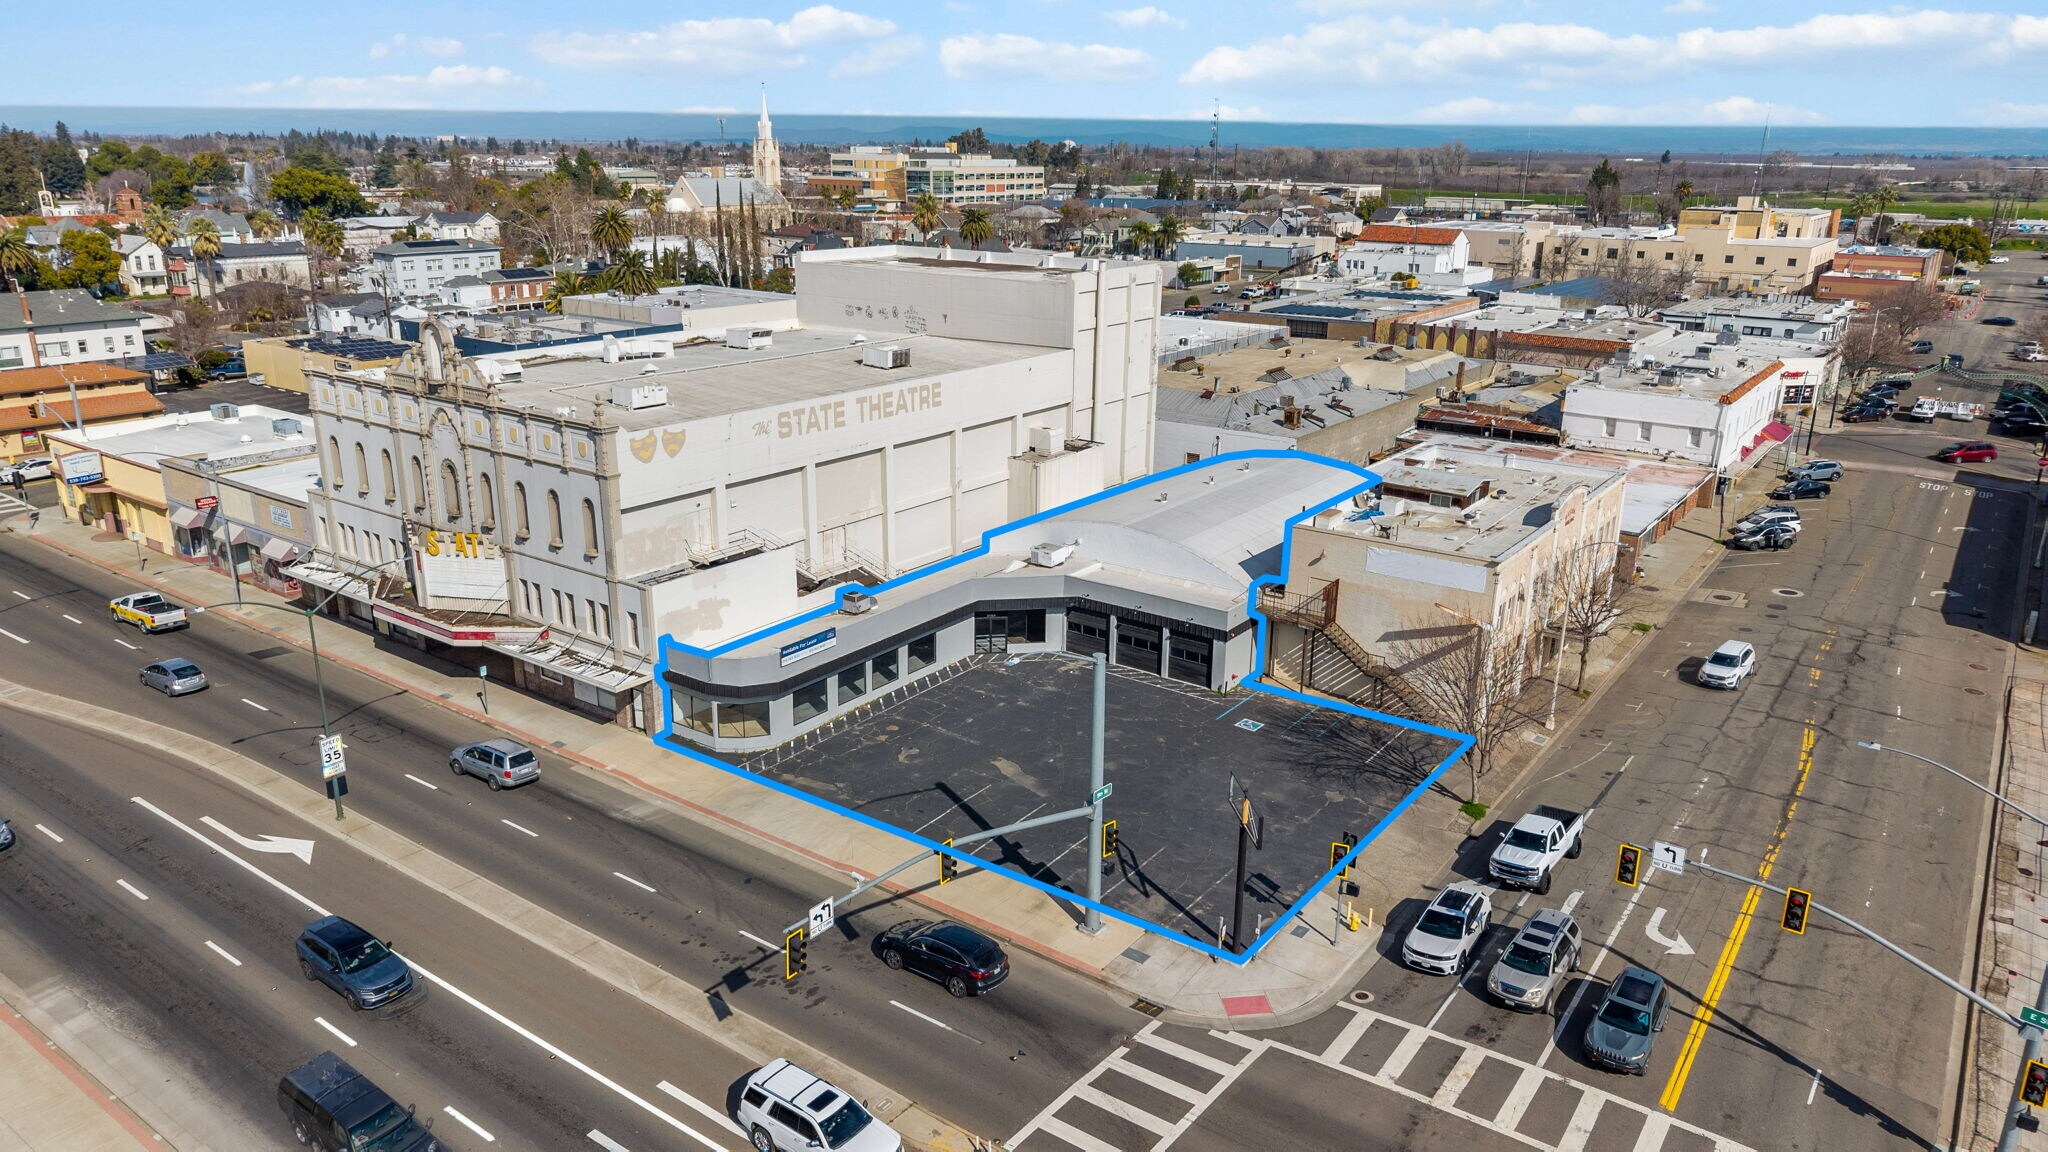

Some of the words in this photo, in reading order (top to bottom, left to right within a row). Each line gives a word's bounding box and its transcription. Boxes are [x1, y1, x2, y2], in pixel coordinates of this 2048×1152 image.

[777, 400, 846, 439] STATE
[856, 382, 942, 423] THEATRE
[1919, 482, 1949, 491] STOP
[426, 530, 501, 560] STATE
[322, 738, 340, 747] SPEED
[325, 744, 339, 753] LIMIT
[325, 750, 341, 763] 35
[2030, 1013, 2038, 1021] E
[2039, 1017, 2048, 1025] S
